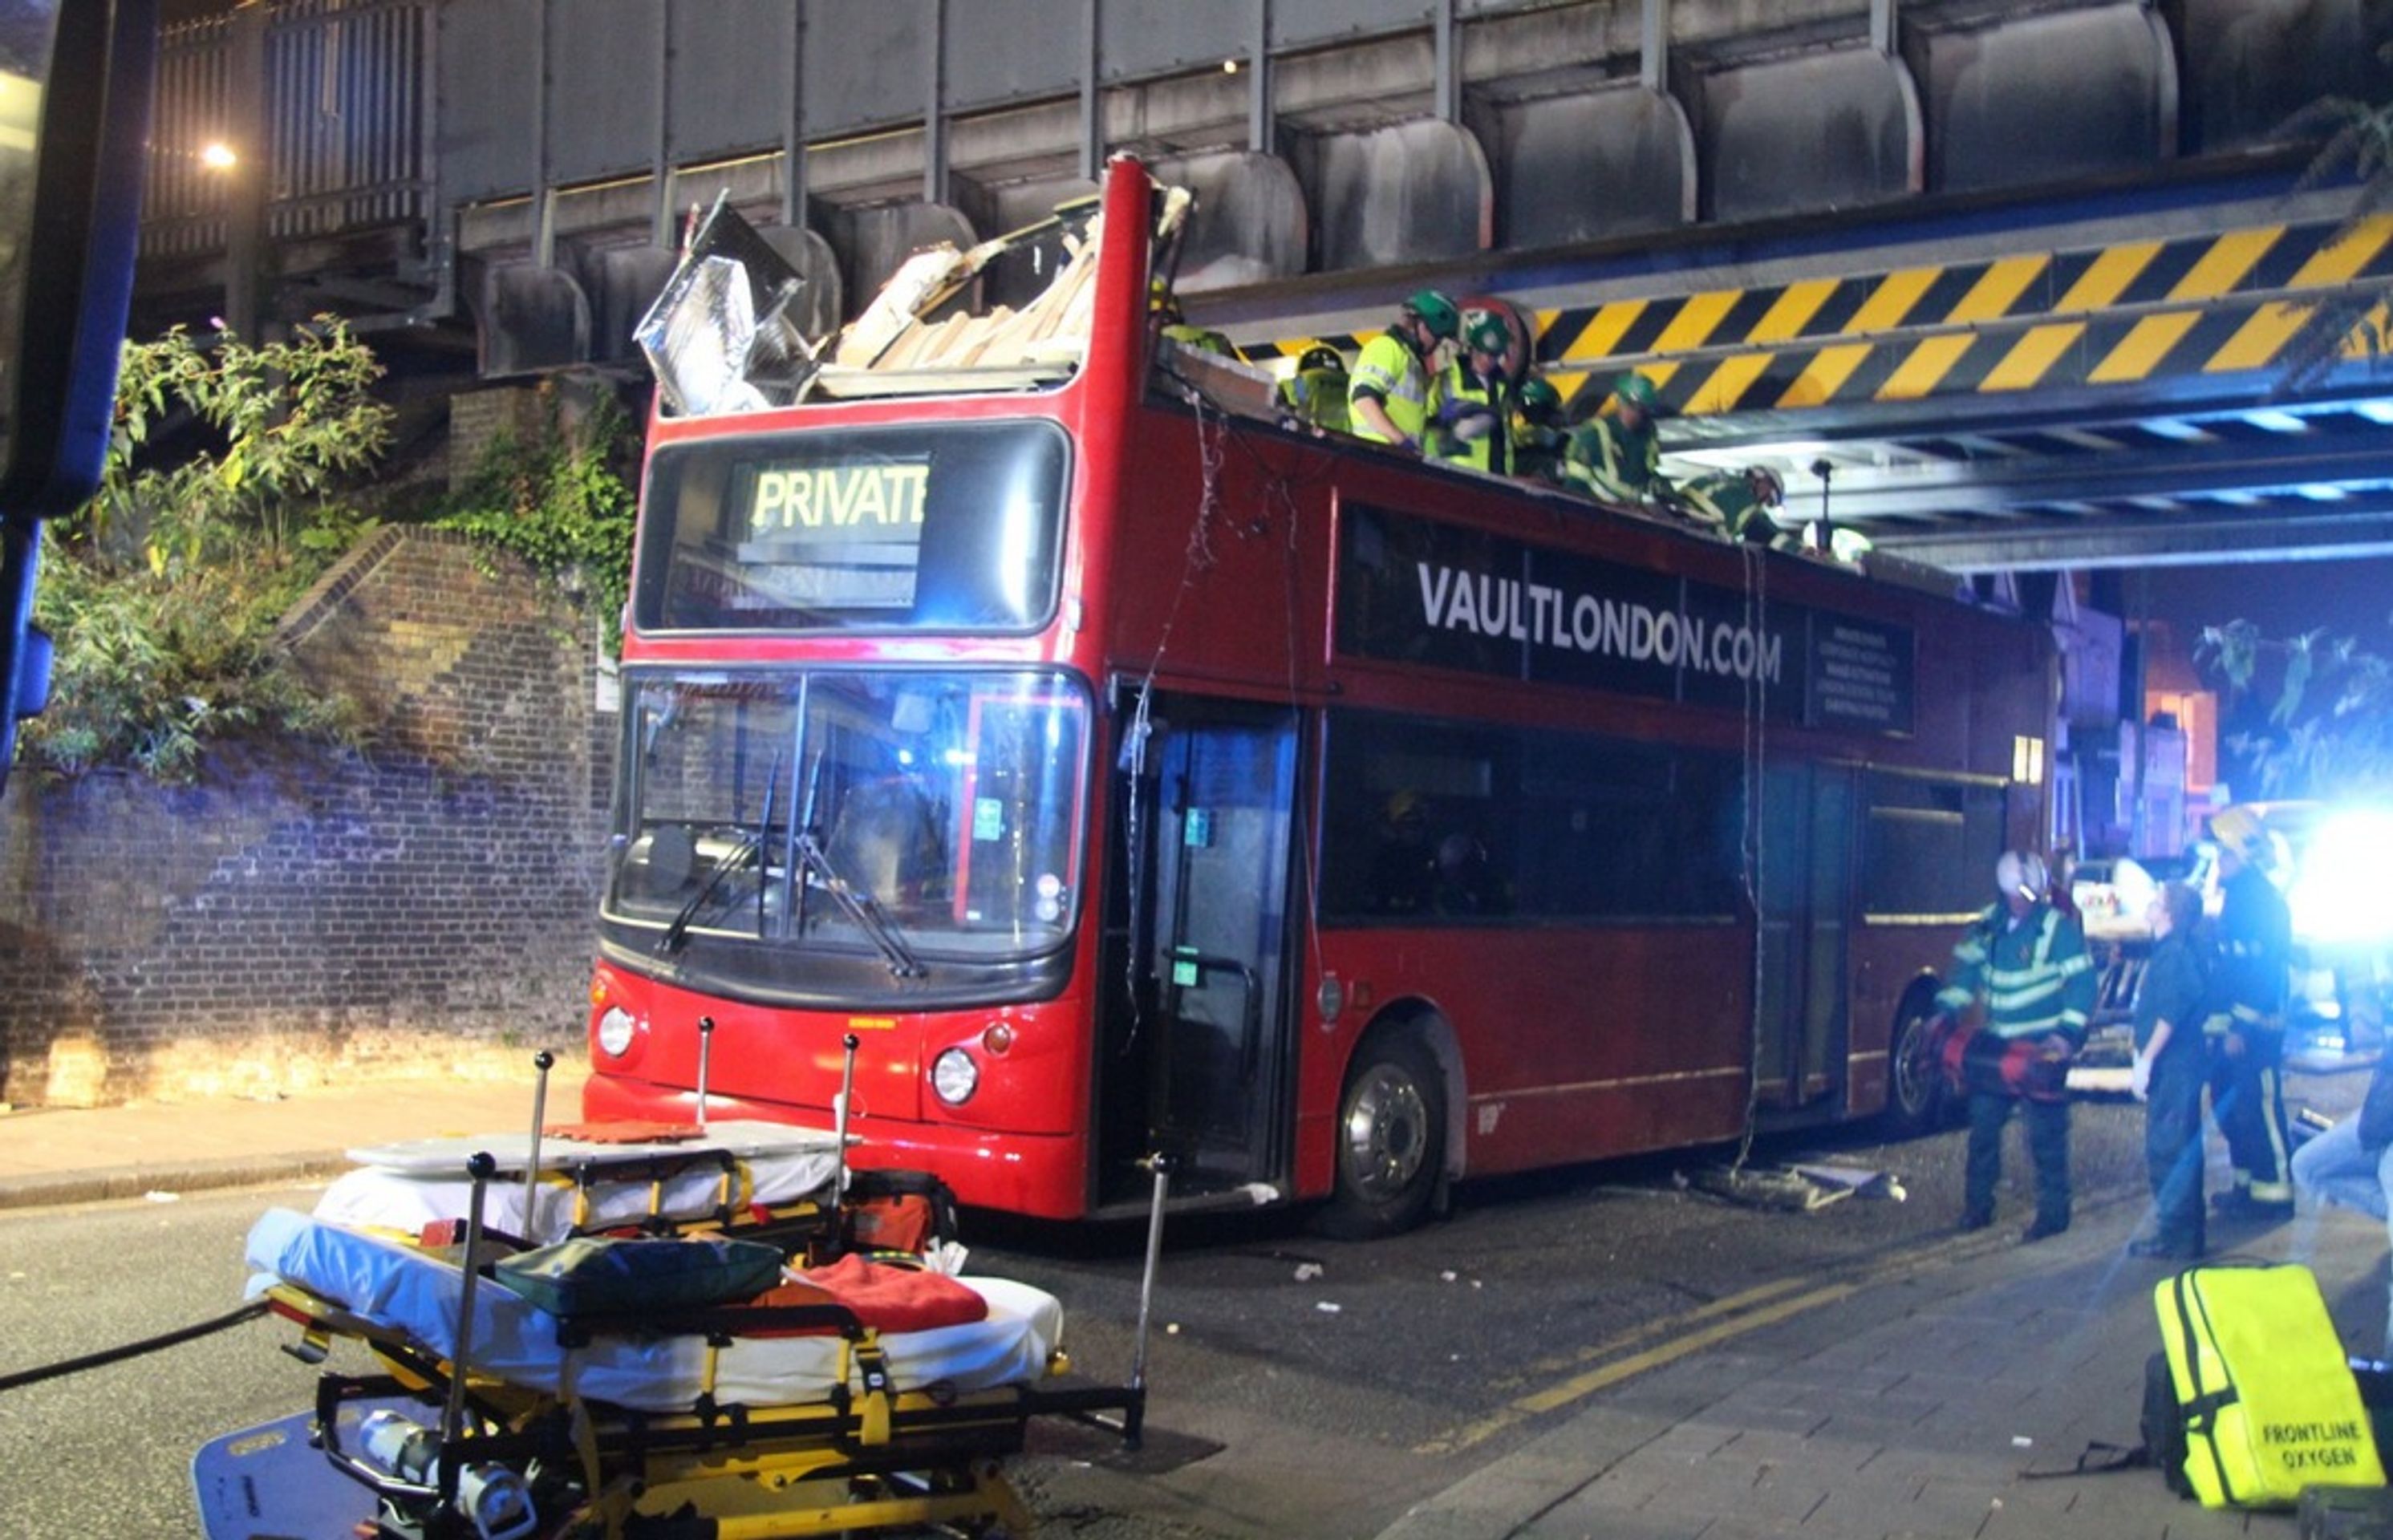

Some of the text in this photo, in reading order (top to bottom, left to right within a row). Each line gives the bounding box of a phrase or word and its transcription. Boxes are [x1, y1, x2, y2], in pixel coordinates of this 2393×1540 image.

[1418, 563, 1781, 684] VAULTLONDON.COM
[2262, 1421, 2361, 1444] FRONTLINE
[2282, 1447, 2356, 1469] OXYGEN
